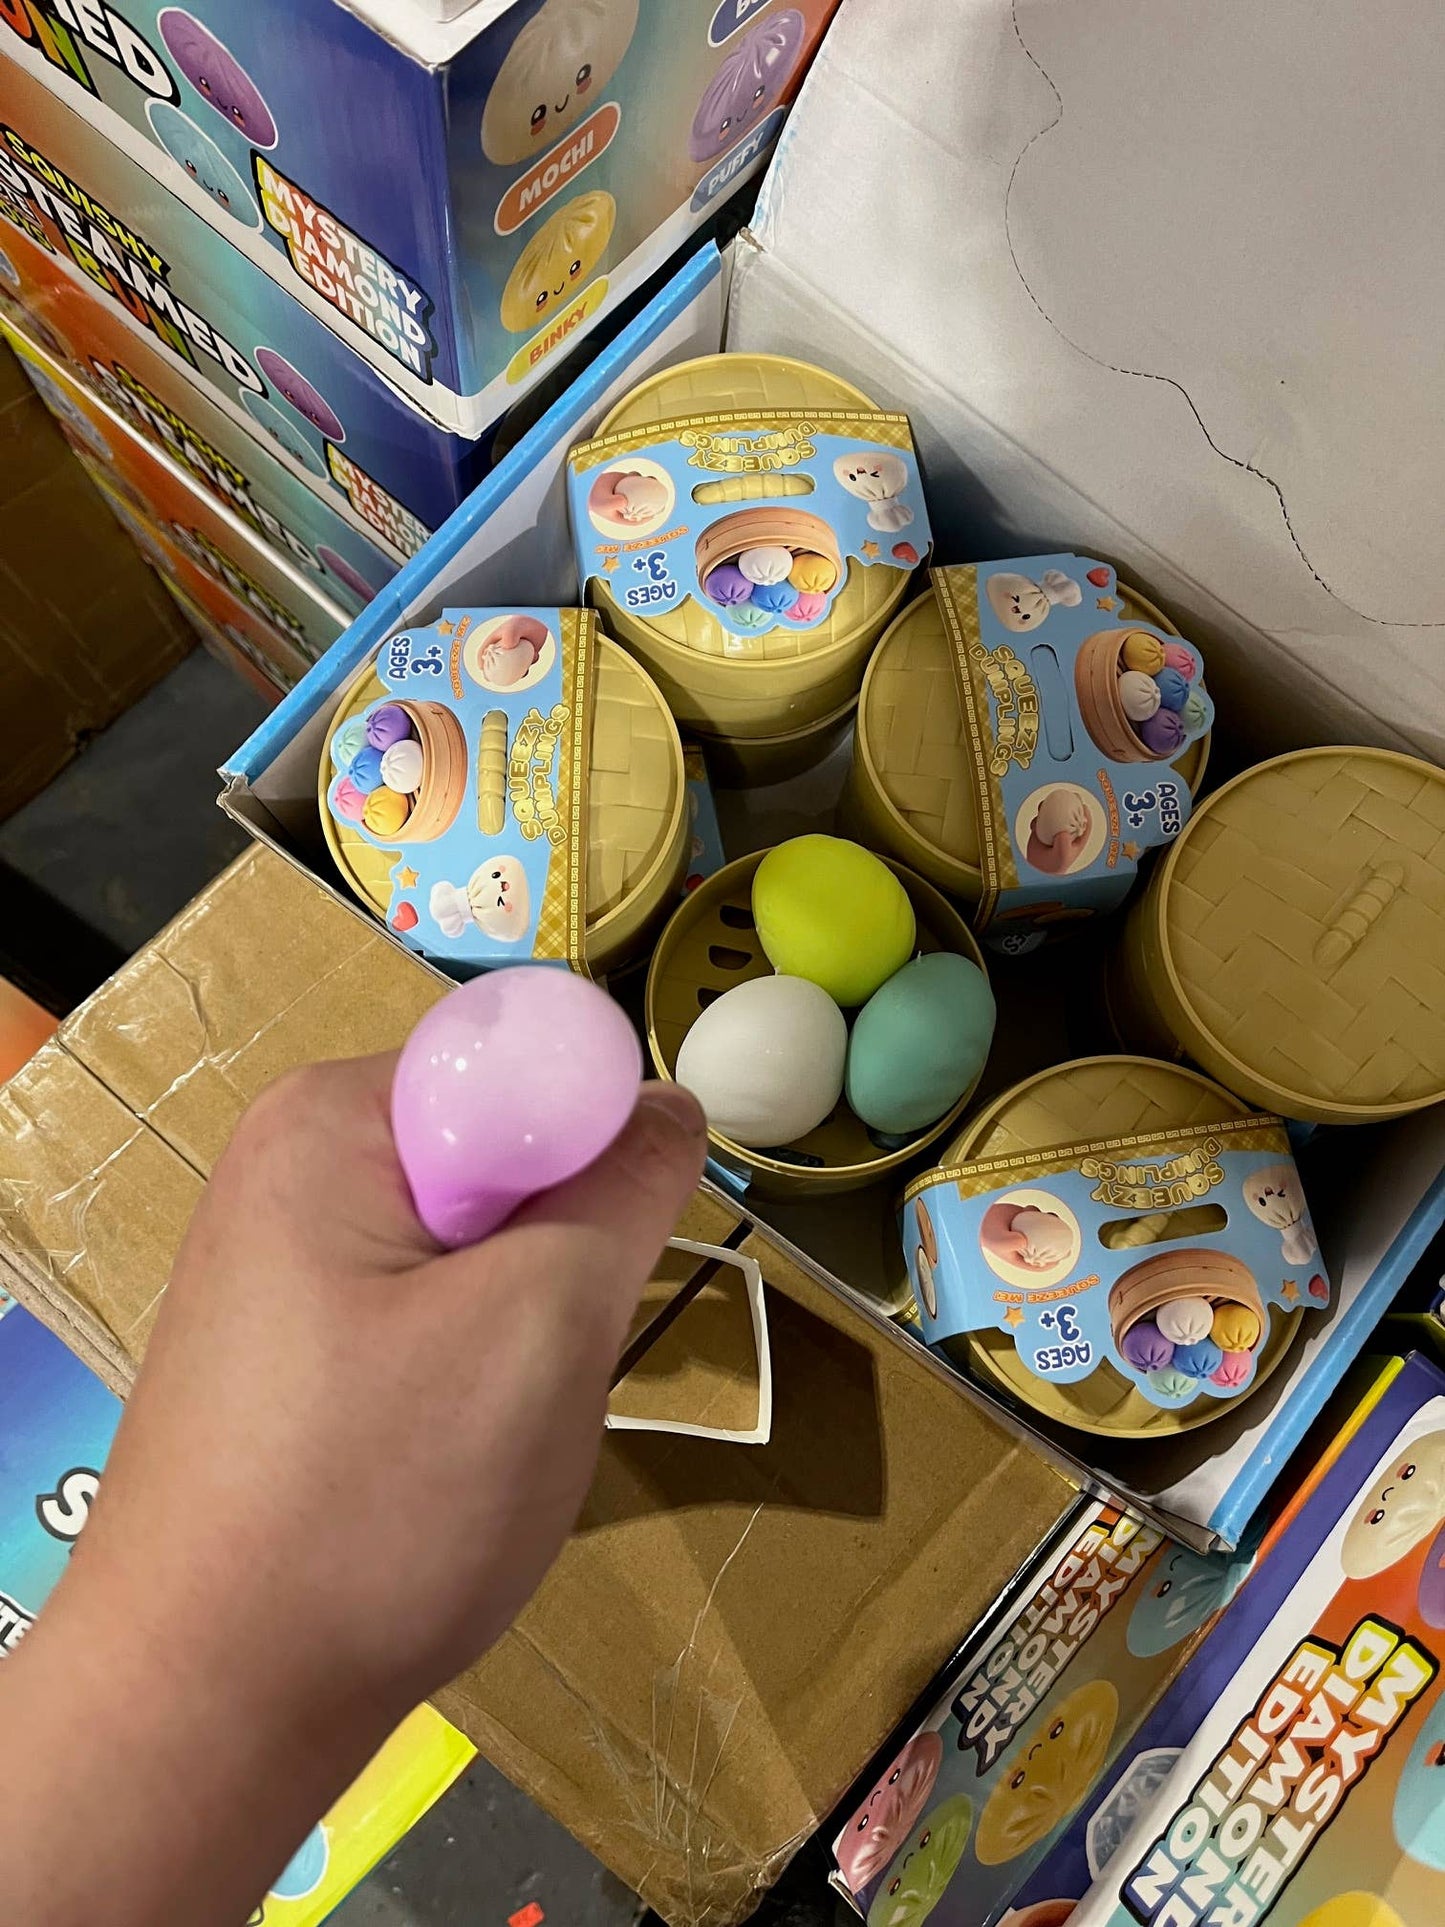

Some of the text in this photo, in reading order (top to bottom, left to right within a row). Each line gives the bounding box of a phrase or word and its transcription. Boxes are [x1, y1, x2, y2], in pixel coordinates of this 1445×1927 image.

[6, 130, 164, 275] SQUISHY
[518, 130, 595, 211] MOCHI
[707, 132, 764, 196] PUFFY
[0, 148, 264, 393] STEAMED
[262, 165, 422, 314] MYSTERY
[268, 200, 426, 346] DIAMOND
[66, 234, 196, 367] BUN
[294, 250, 421, 373] EDITION
[529, 302, 587, 366] BINKY
[678, 421, 818, 453] DUMPLINGS
[687, 441, 816, 473] SQUEEZY
[333, 446, 432, 541] MYSTER
[335, 464, 424, 550] DIAMO
[628, 582, 676, 605] AGES
[633, 551, 667, 580] 3+
[388, 637, 411, 679] AGES
[410, 646, 444, 675] 3+
[449, 639, 464, 700] SQUEEZE
[967, 642, 1017, 777] DUMPLINGS
[993, 644, 1039, 770] SQUEEZY
[508, 708, 545, 841] SQUEEZY
[531, 703, 571, 846] DUMPLINGS
[1122, 790, 1157, 828] 3+
[1157, 783, 1180, 834] AGES
[1079, 1136, 1223, 1184] DUMPLINGS
[1089, 1162, 1225, 1210] SQUEEZY
[1026, 1273, 1100, 1303] SQUEEZE
[1039, 1305, 1082, 1342] 3+
[1035, 1342, 1091, 1371] AGES
[960, 1527, 1107, 1712] EDITION
[966, 1514, 1143, 1739] DIAMOND
[984, 1525, 1161, 1764] MYSTERY
[1130, 1648, 1328, 1909] EDITION
[1205, 1652, 1425, 1927] MYSTER
